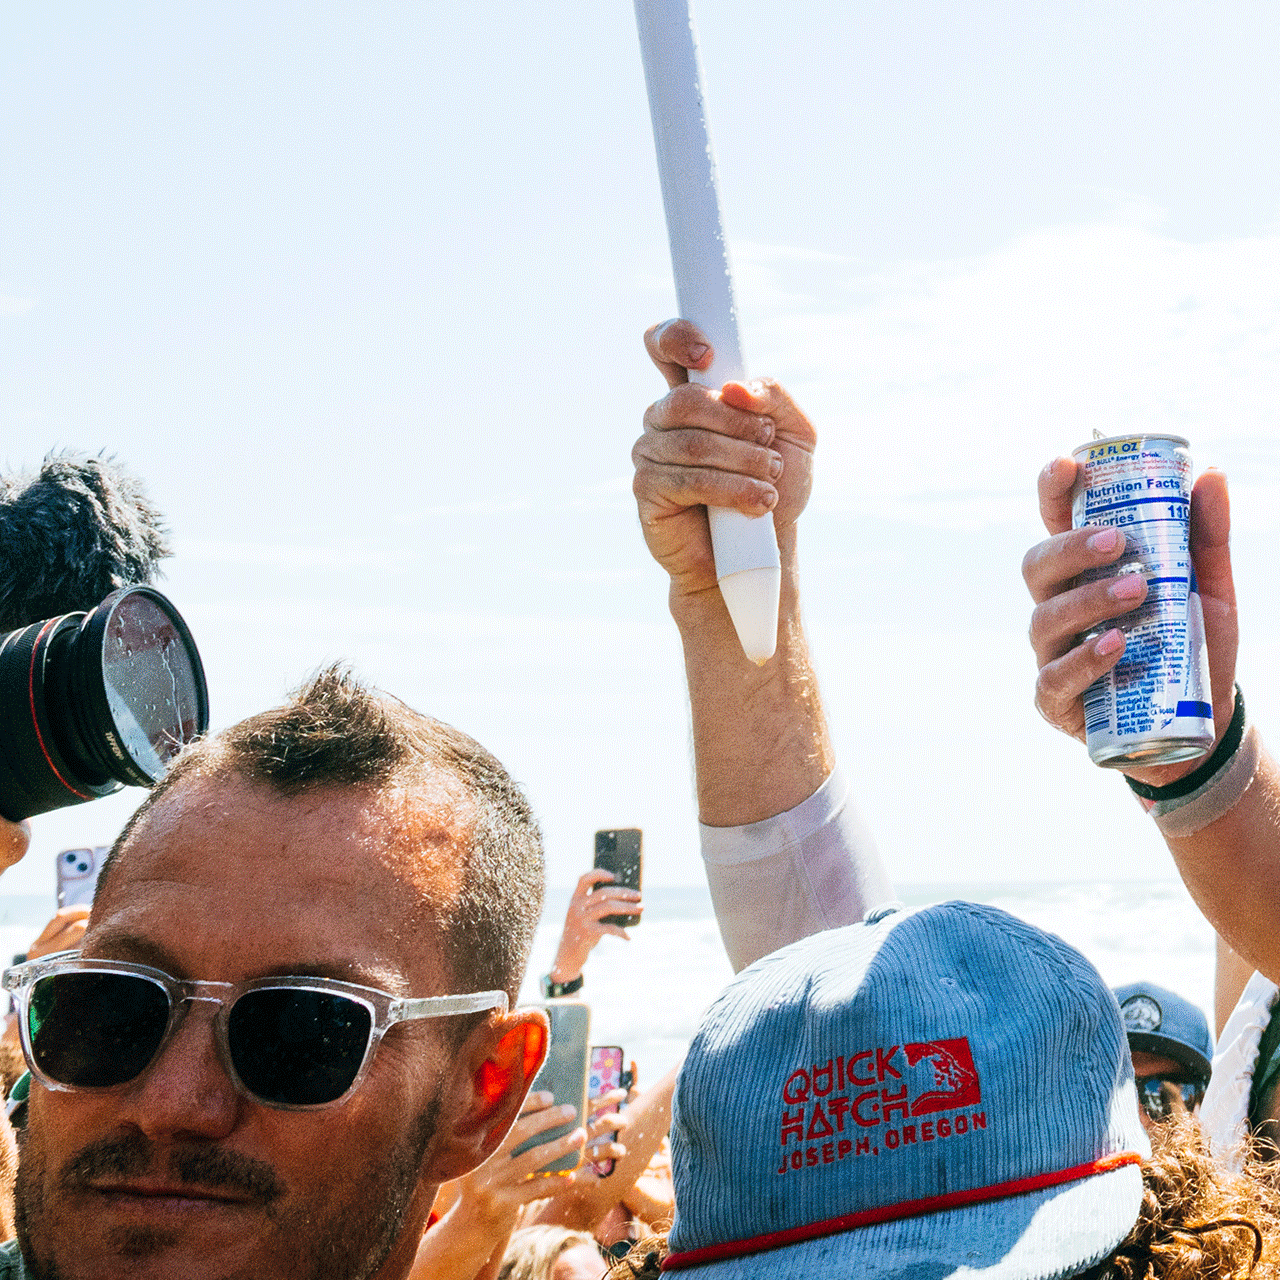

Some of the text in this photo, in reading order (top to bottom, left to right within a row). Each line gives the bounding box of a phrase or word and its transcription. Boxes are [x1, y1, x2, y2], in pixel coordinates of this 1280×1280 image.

[1107, 445, 1118, 455] FL
[1121, 442, 1138, 453] OZ
[1116, 454, 1140, 462] Energy
[1086, 478, 1180, 500] Nutrition Facts
[1085, 497, 1113, 508] Serving
[1114, 493, 1131, 502] size
[1115, 506, 1137, 514] serving
[1083, 504, 1190, 527] Calories 110
[782, 1045, 902, 1105] QUICK
[780, 1084, 909, 1146] HATCH
[777, 1111, 987, 1175] JOSEPH, OREGON
